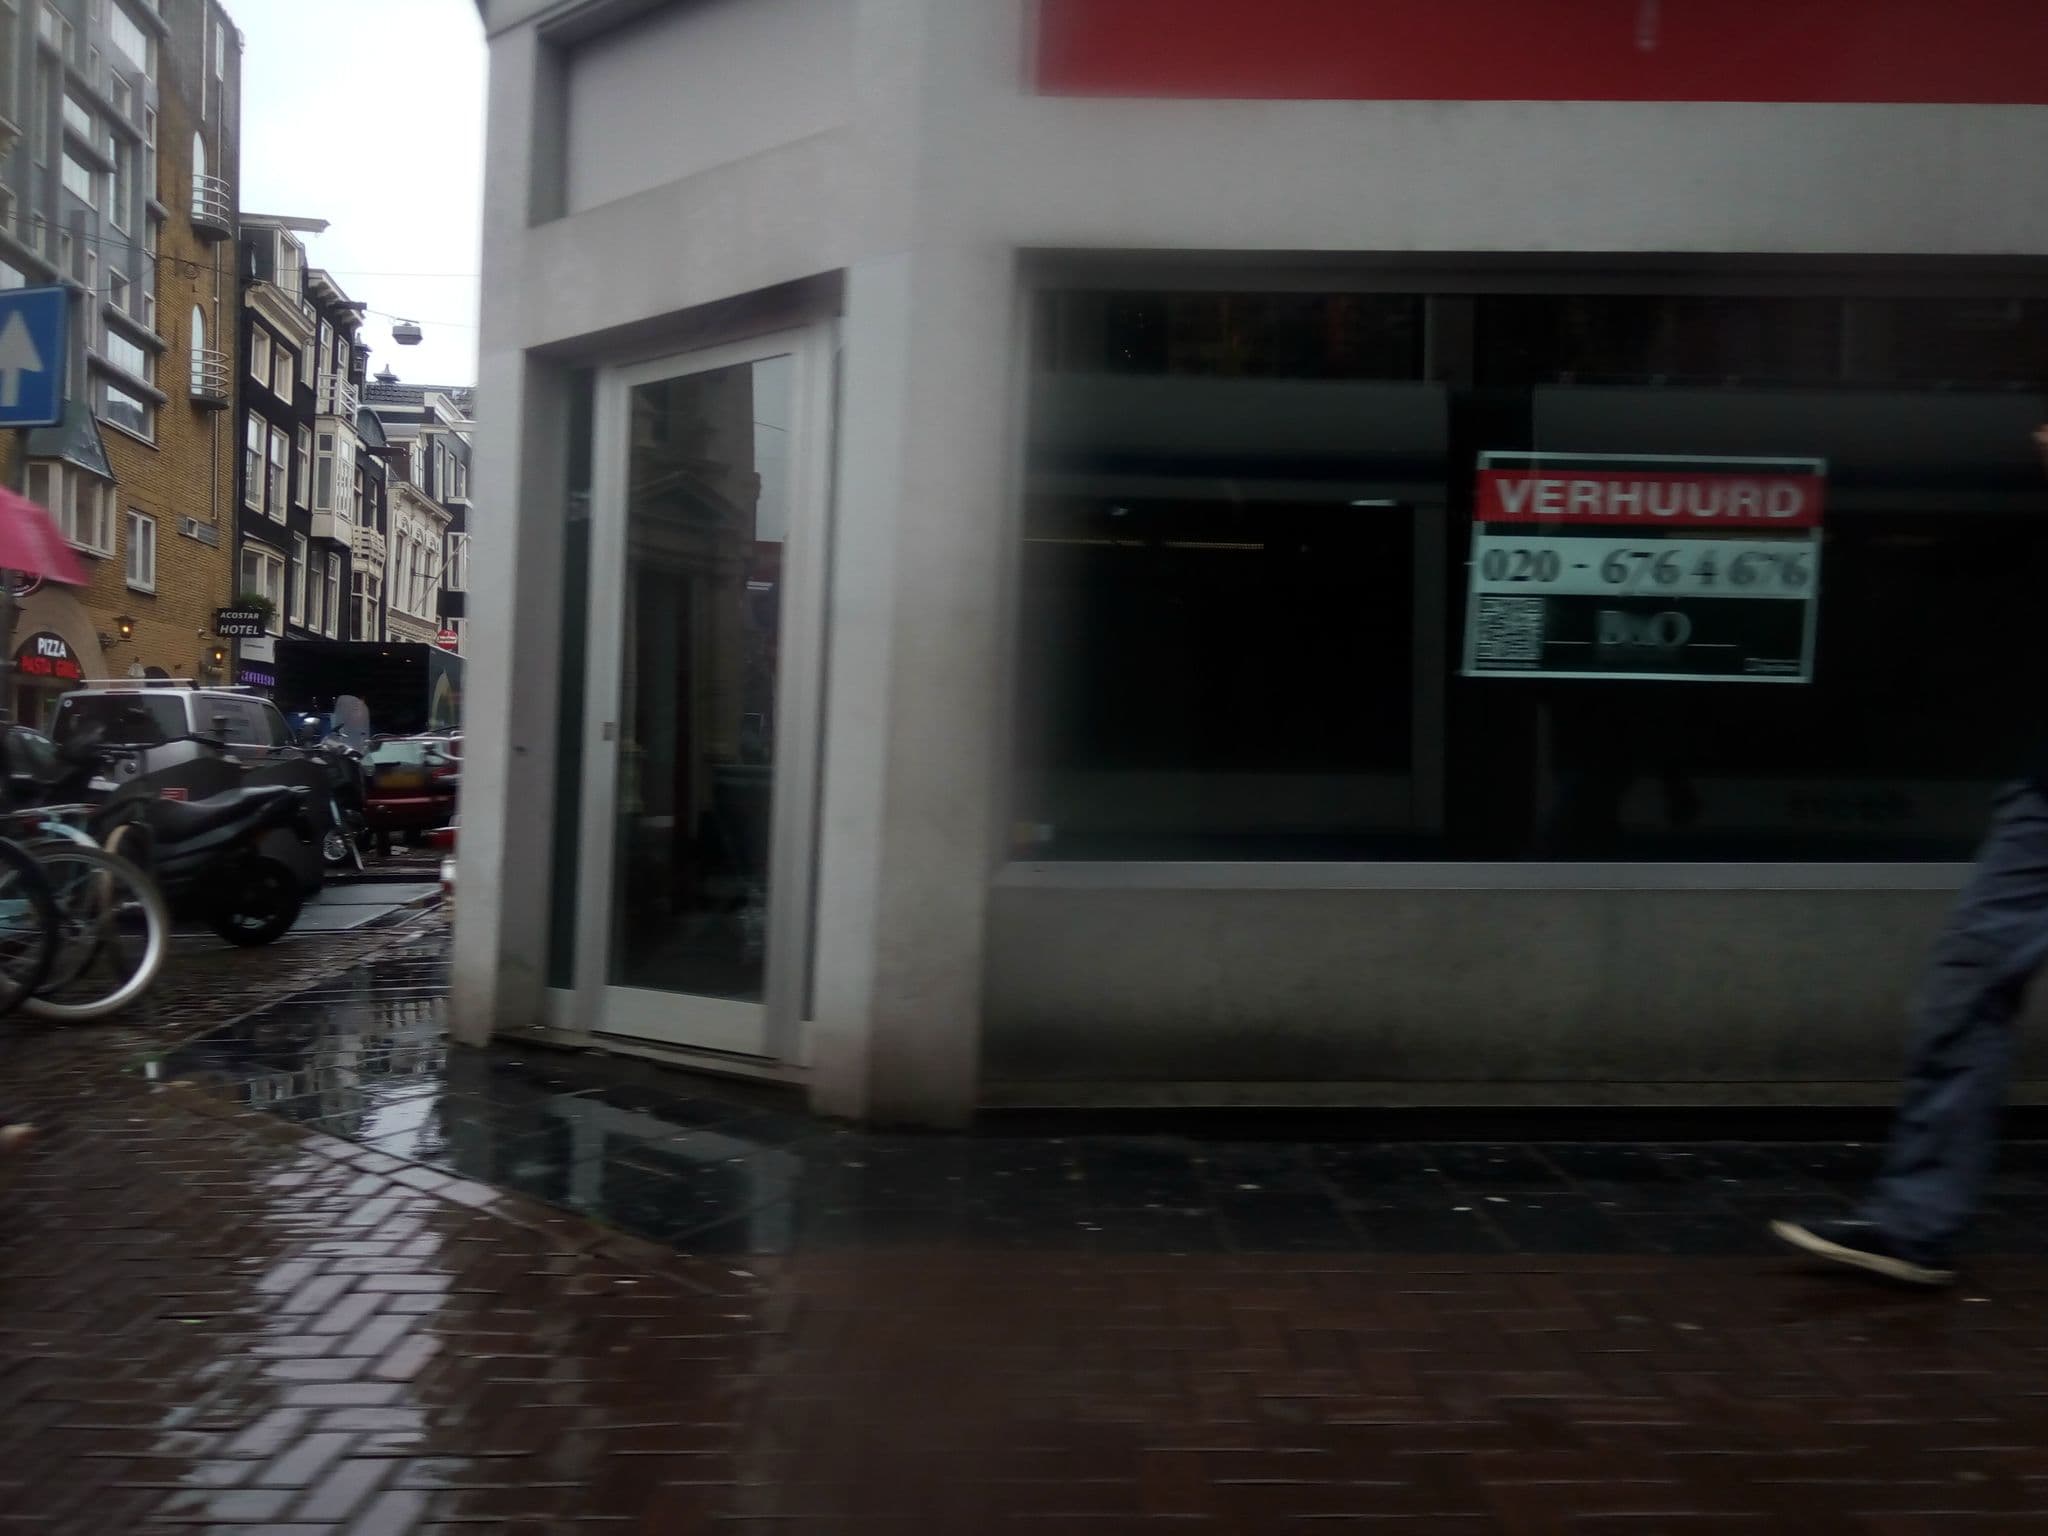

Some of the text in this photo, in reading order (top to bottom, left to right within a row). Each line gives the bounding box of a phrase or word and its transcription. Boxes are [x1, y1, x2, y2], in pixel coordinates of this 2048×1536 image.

[1496, 478, 1804, 518] VERHUURD
[1482, 548, 1561, 582] 020
[220, 625, 259, 635] HOTEL
[38, 638, 66, 658] PIZZA
